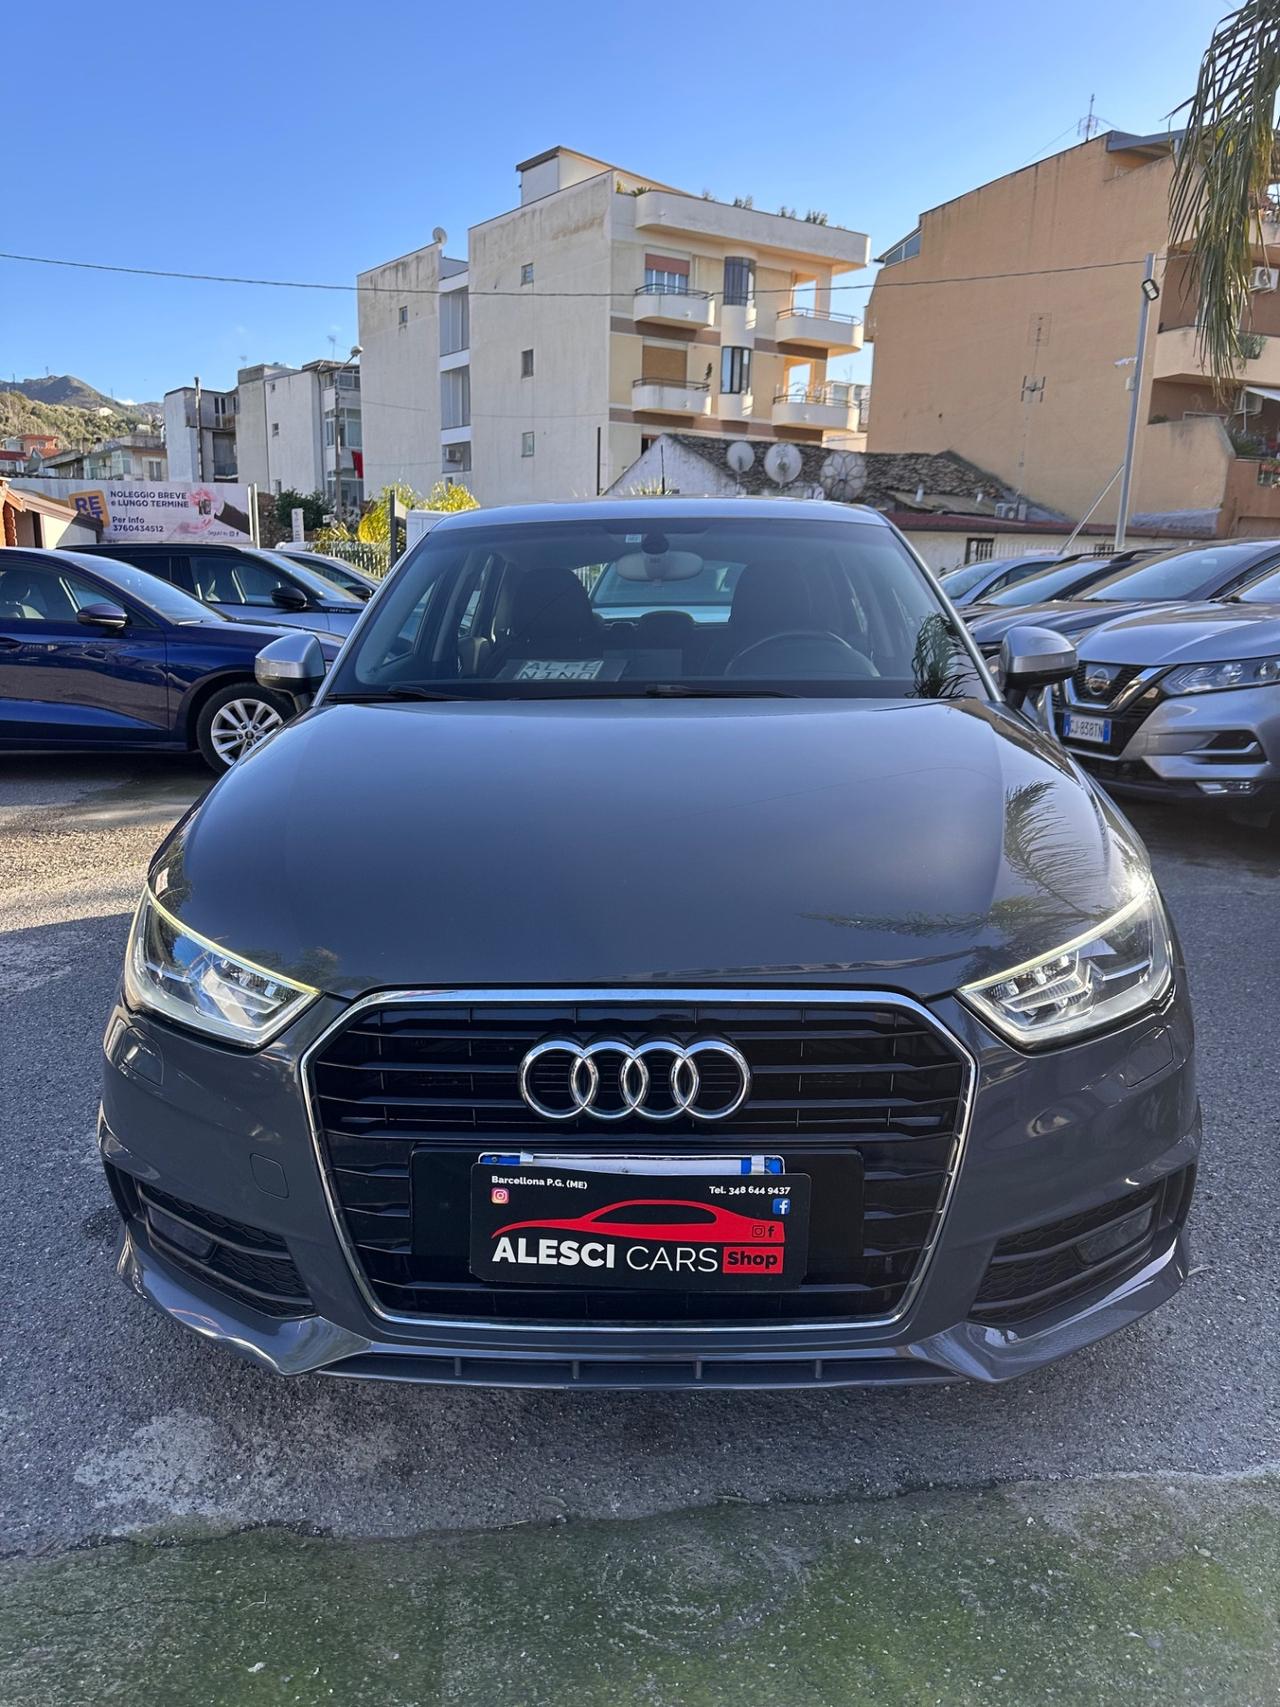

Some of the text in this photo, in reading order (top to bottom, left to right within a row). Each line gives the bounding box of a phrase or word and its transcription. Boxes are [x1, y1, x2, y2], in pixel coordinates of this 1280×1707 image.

[110, 490, 187, 500] NOLEGGIO BREVE
[74, 496, 101, 512] RE
[118, 499, 149, 508] LUNGO
[150, 500, 189, 509] TERMINE
[112, 516, 145, 524] Per Info
[113, 524, 164, 533] 3760434512
[491, 1175, 588, 1190] Barcellona P.G. (ME)
[709, 1185, 791, 1196] Tel. 348 644 9437
[491, 1237, 778, 1272] ALESCI CARS Shop
